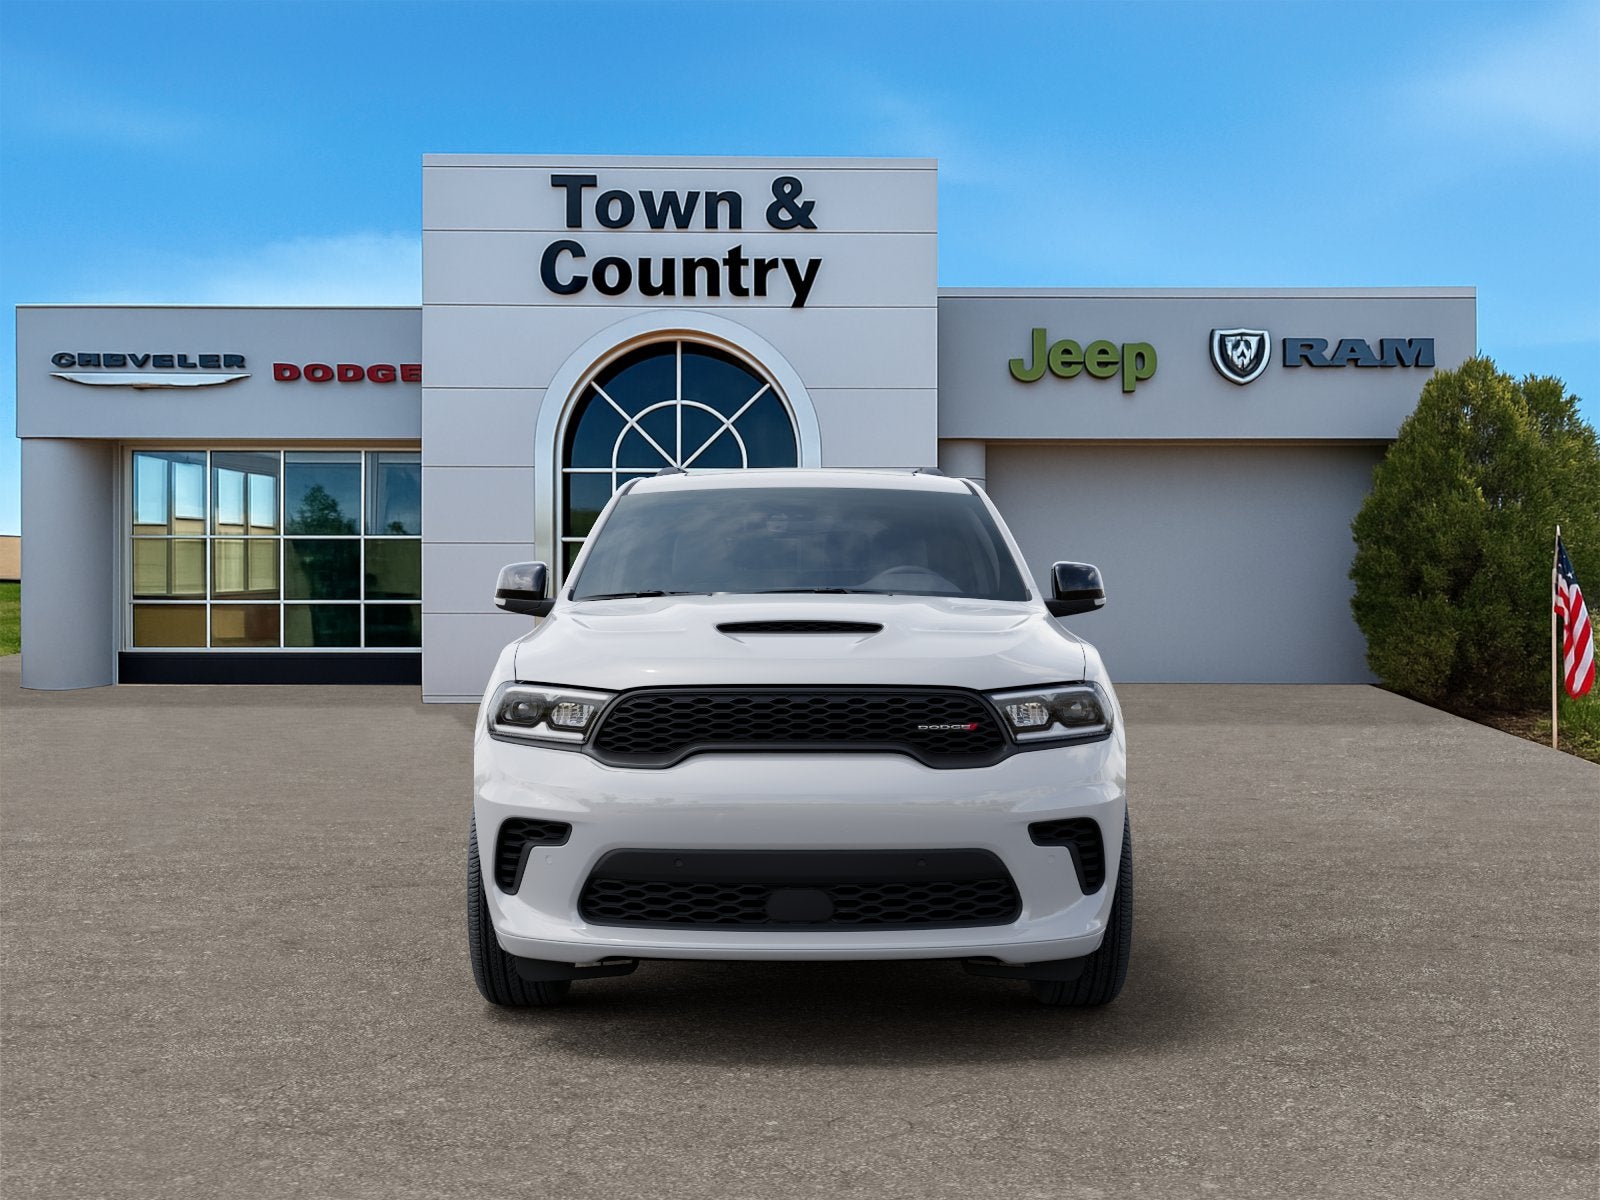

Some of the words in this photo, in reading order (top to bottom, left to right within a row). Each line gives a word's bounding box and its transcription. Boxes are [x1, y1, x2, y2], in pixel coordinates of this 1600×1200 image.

[551, 174, 742, 230] Town
[765, 175, 818, 230] &
[540, 239, 822, 308] Country
[273, 363, 422, 382] DODGE
[1009, 328, 1158, 393] Jeep
[1283, 337, 1435, 367] RAM
